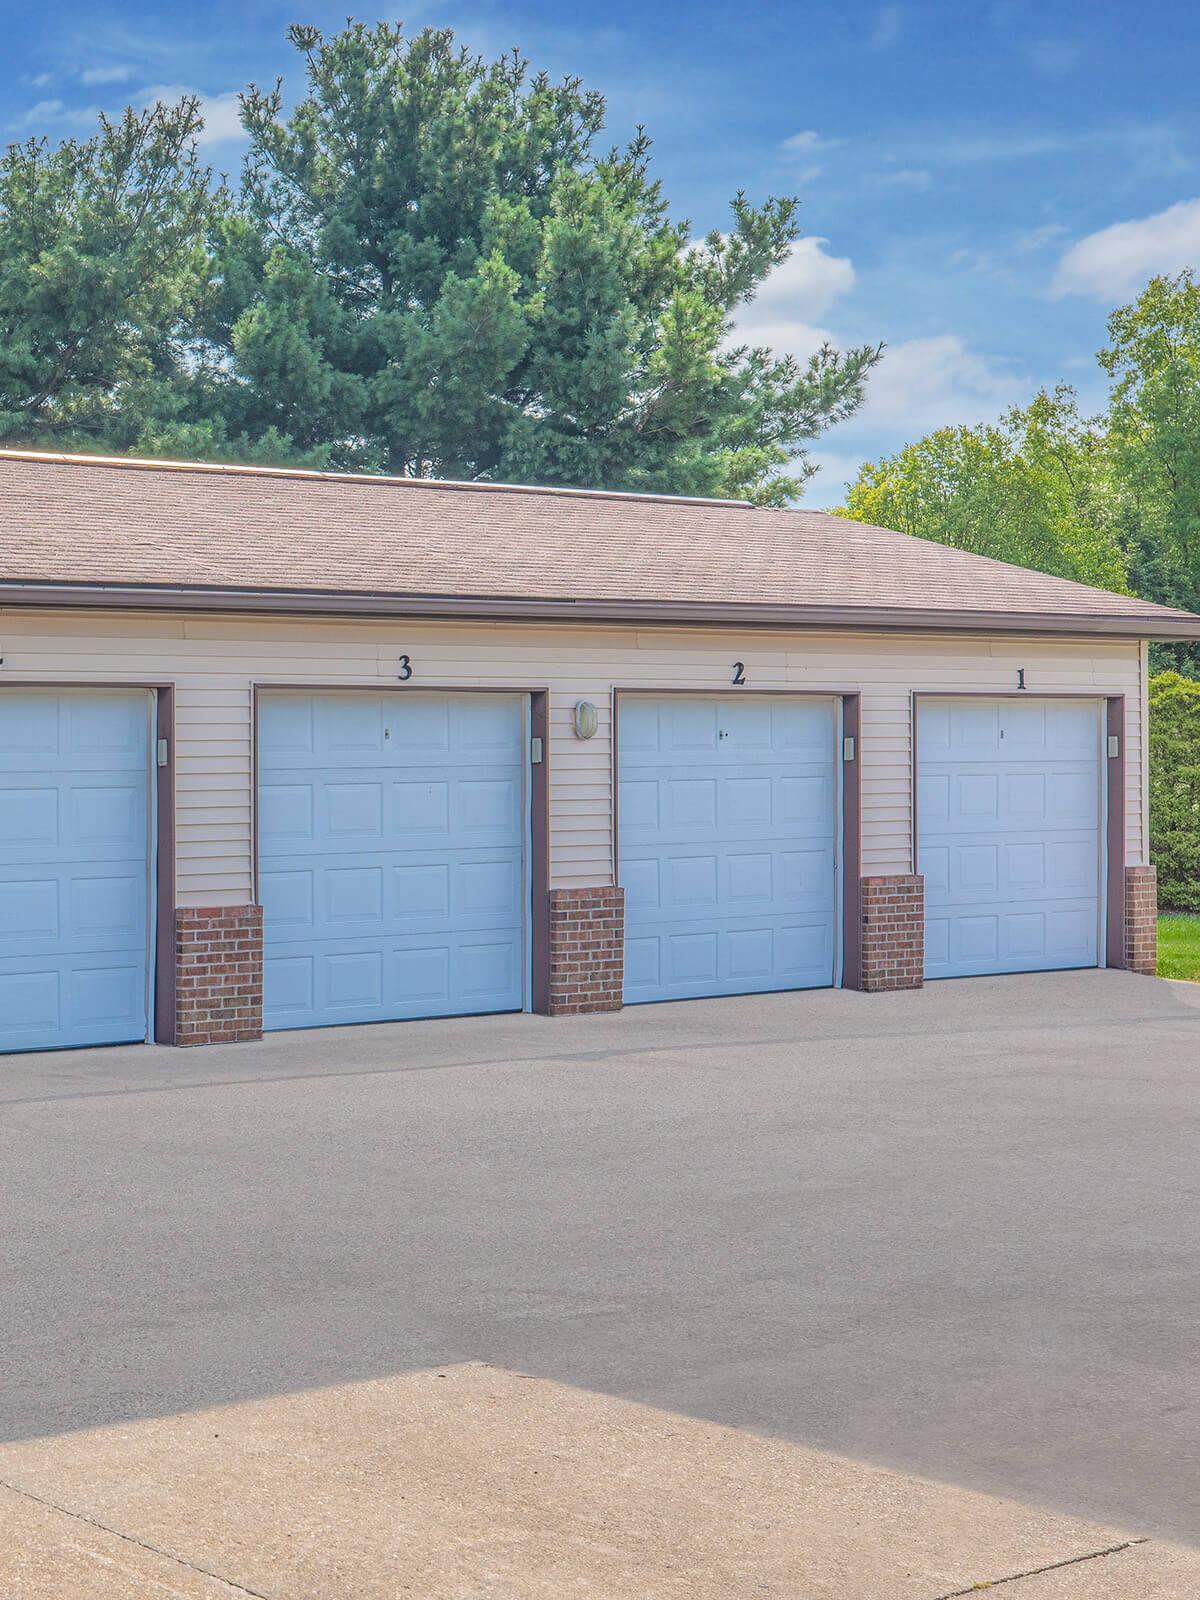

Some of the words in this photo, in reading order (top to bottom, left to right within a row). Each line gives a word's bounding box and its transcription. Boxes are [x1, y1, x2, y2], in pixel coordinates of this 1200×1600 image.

[397, 655, 413, 681] 3
[731, 662, 746, 686] 2
[1016, 669, 1027, 690] 1
